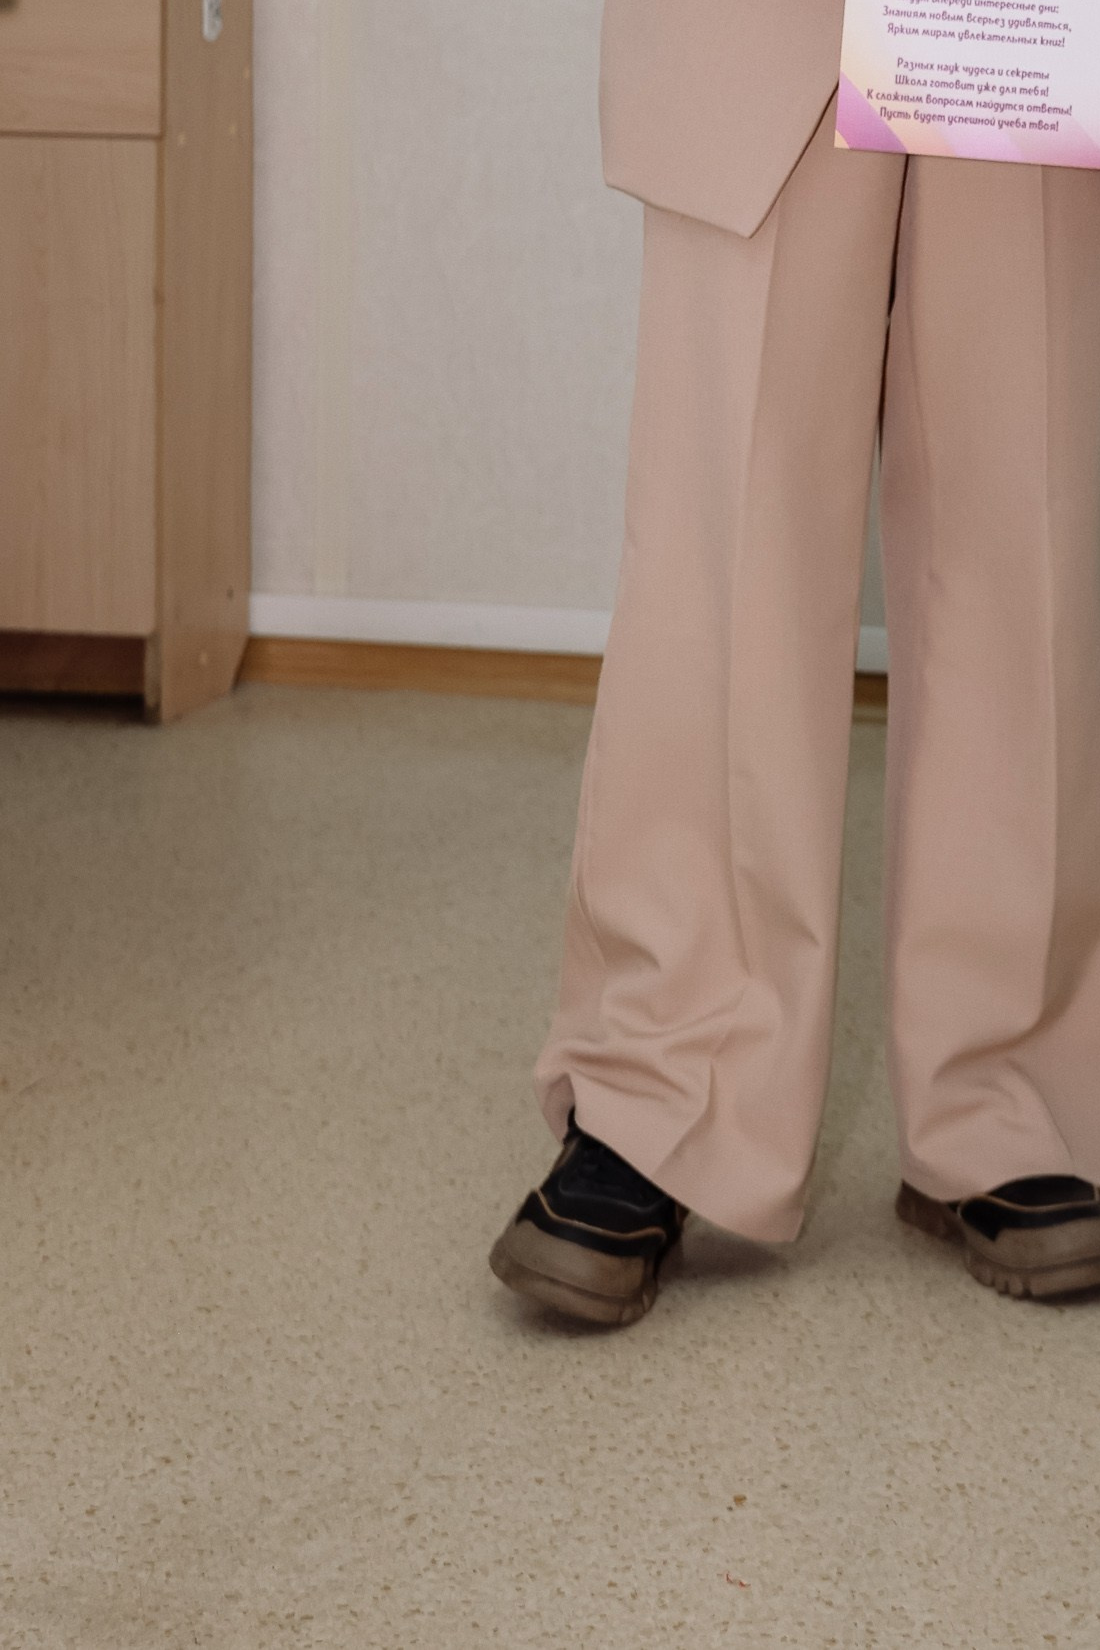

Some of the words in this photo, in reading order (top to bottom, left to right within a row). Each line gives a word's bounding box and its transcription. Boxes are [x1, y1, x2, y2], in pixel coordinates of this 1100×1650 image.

[882, 5, 927, 19] Знаниям
[929, 10, 964, 23] новым
[966, 13, 1006, 28] всерьез
[1007, 17, 1072, 32] удивляться,
[887, 22, 920, 37] Ярким
[921, 28, 956, 40] мирам
[957, 29, 1038, 46] увлекательных
[1040, 36, 1065, 48] книг!
[896, 57, 935, 71] Разных
[937, 62, 960, 75] наук
[961, 65, 996, 77] чудеса
[997, 68, 1004, 76] и
[1005, 67, 1050, 80] секреты
[894, 74, 928, 87] Школа
[929, 79, 975, 91] готовит
[977, 82, 997, 94] уже
[999, 85, 1017, 96] для
[1019, 85, 1049, 98] тебя!
[866, 88, 874, 100] К
[875, 91, 923, 103] сложным
[925, 93, 974, 108] вопросам
[975, 99, 1025, 113] найдутся
[1026, 103, 1072, 116] ответы!
[879, 106, 912, 121] Пусть
[913, 110, 946, 125] будет
[947, 115, 996, 128] успешной
[997, 117, 1027, 130] учеба
[1028, 119, 1059, 132] твоя!
